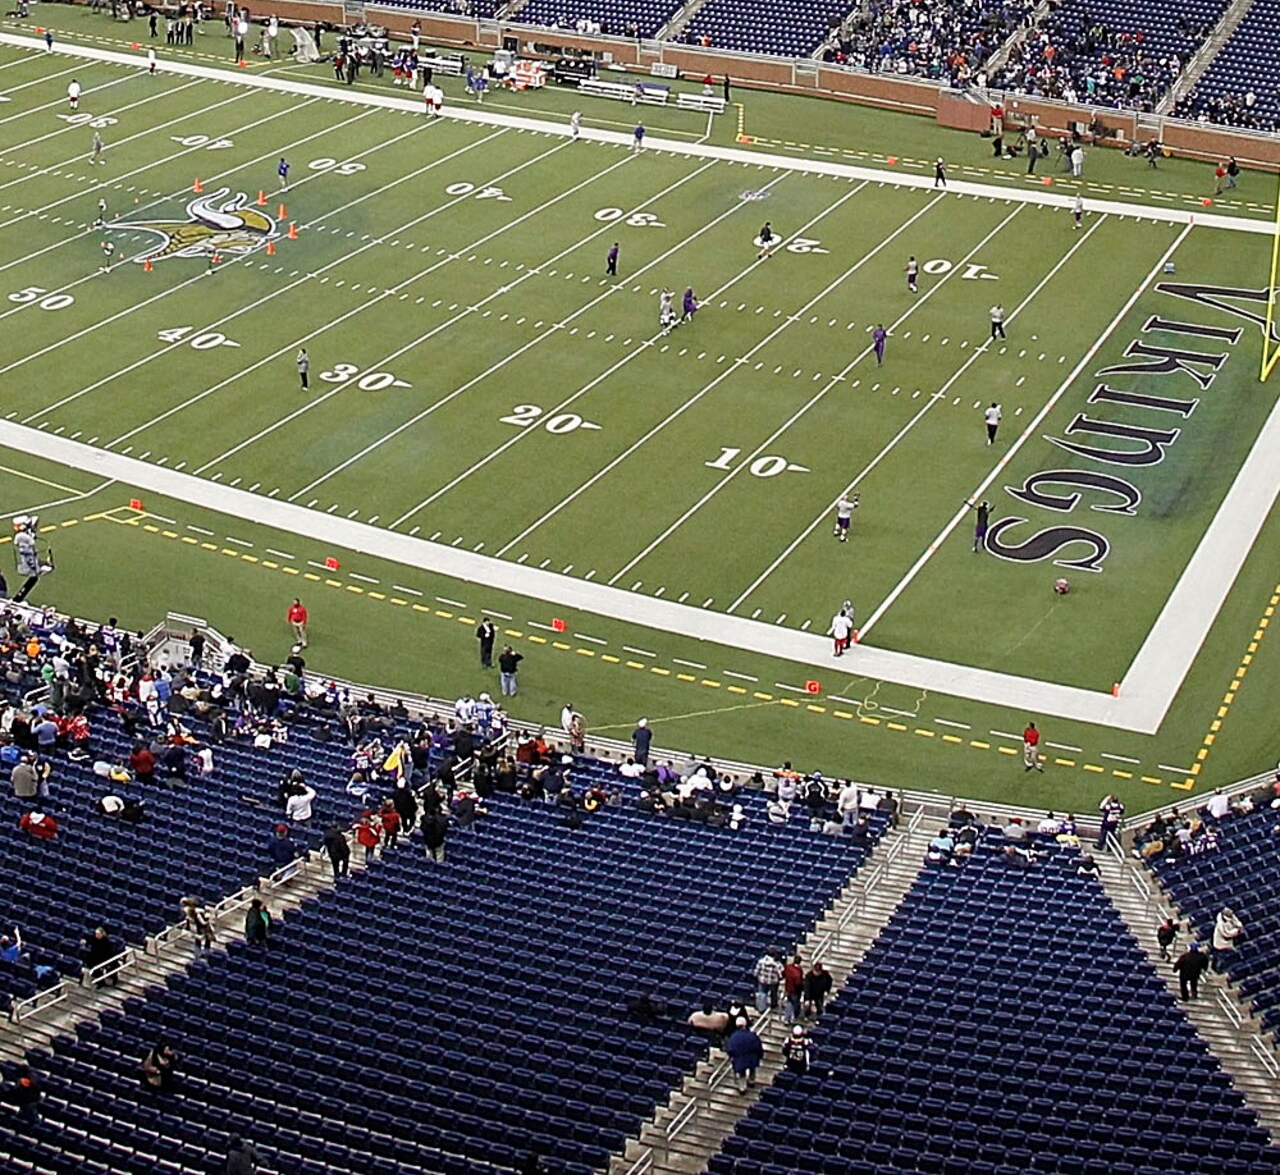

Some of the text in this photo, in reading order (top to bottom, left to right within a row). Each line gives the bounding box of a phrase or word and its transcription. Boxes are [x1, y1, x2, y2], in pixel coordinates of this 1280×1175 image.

[307, 157, 368, 176] 50
[8, 286, 75, 312] 50
[157, 325, 226, 350] 40
[319, 363, 396, 392] 30
[498, 404, 583, 434] 20
[704, 447, 789, 478] 10
[808, 681, 818, 692] G
